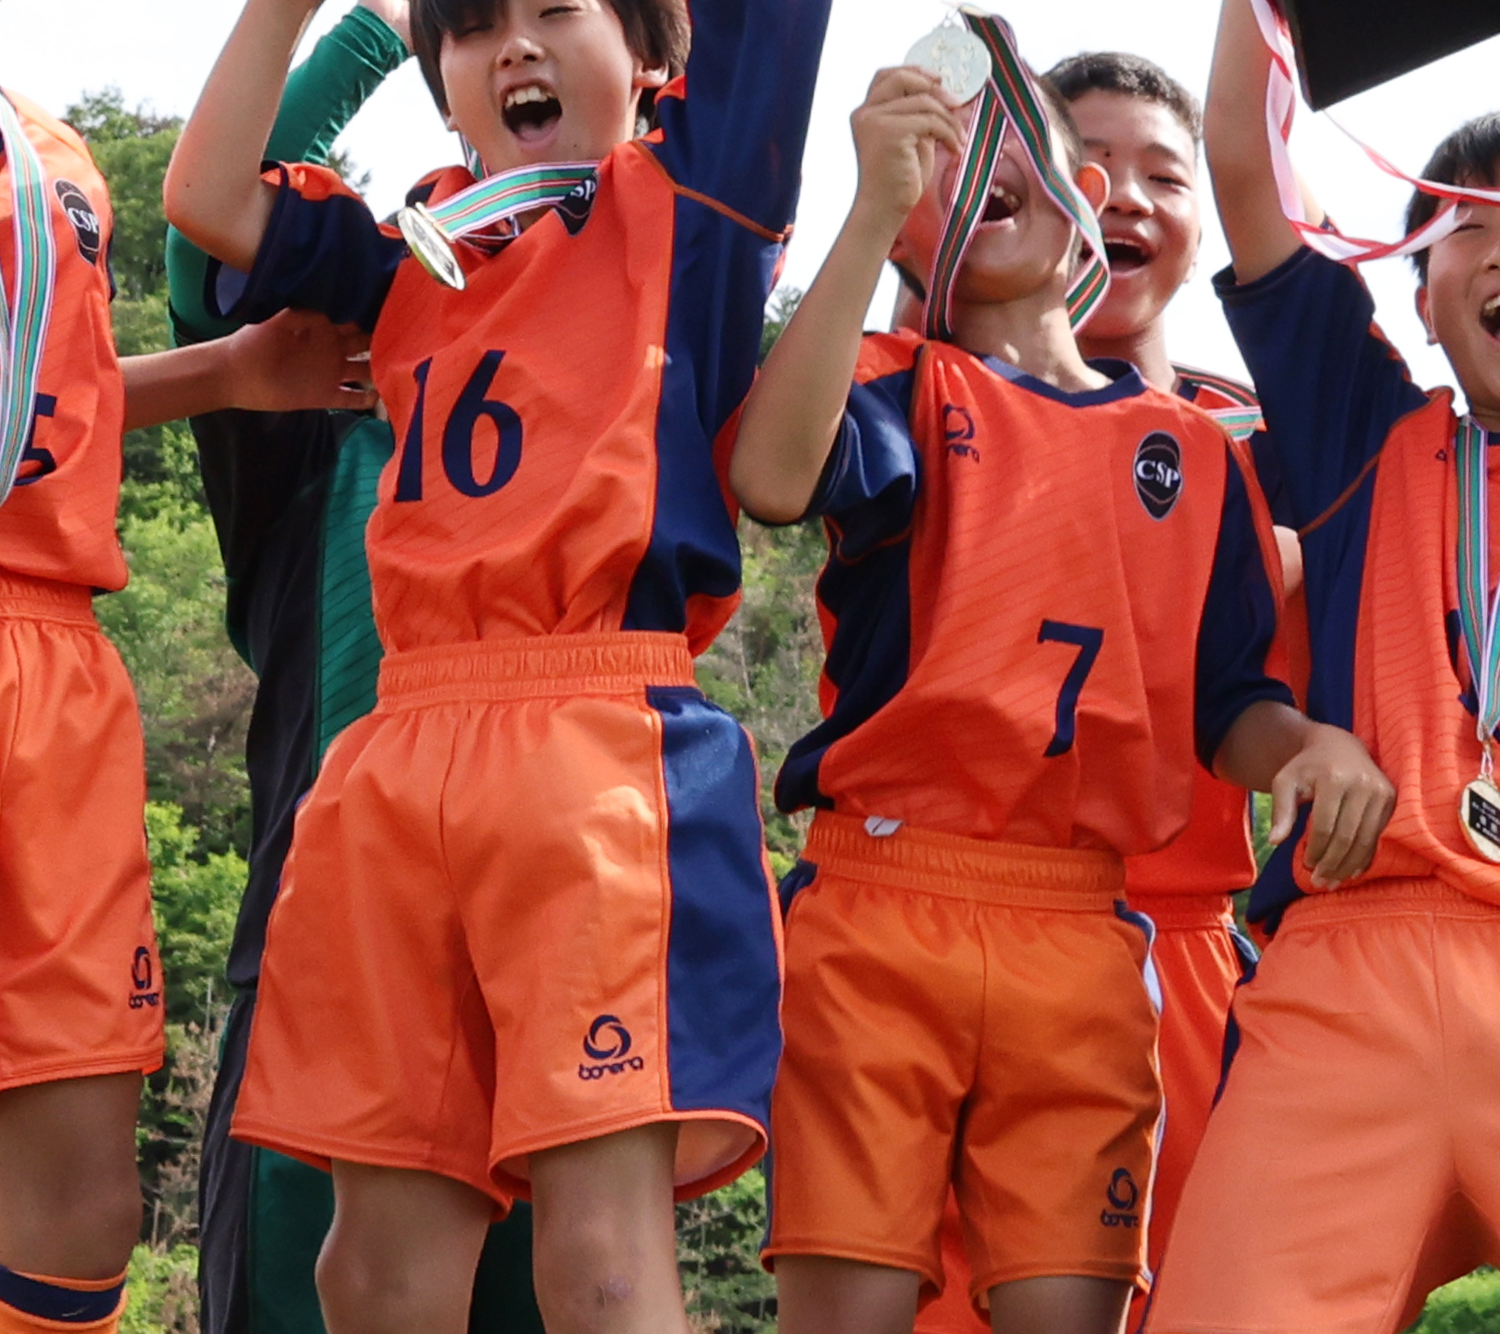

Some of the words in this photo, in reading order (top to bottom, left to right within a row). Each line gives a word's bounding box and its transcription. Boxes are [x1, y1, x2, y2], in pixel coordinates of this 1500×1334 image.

[569, 176, 597, 202] SP
[66, 204, 100, 236] CSP
[395, 348, 524, 504] 16
[1134, 458, 1182, 490] CSP
[1037, 620, 1106, 757] 7
